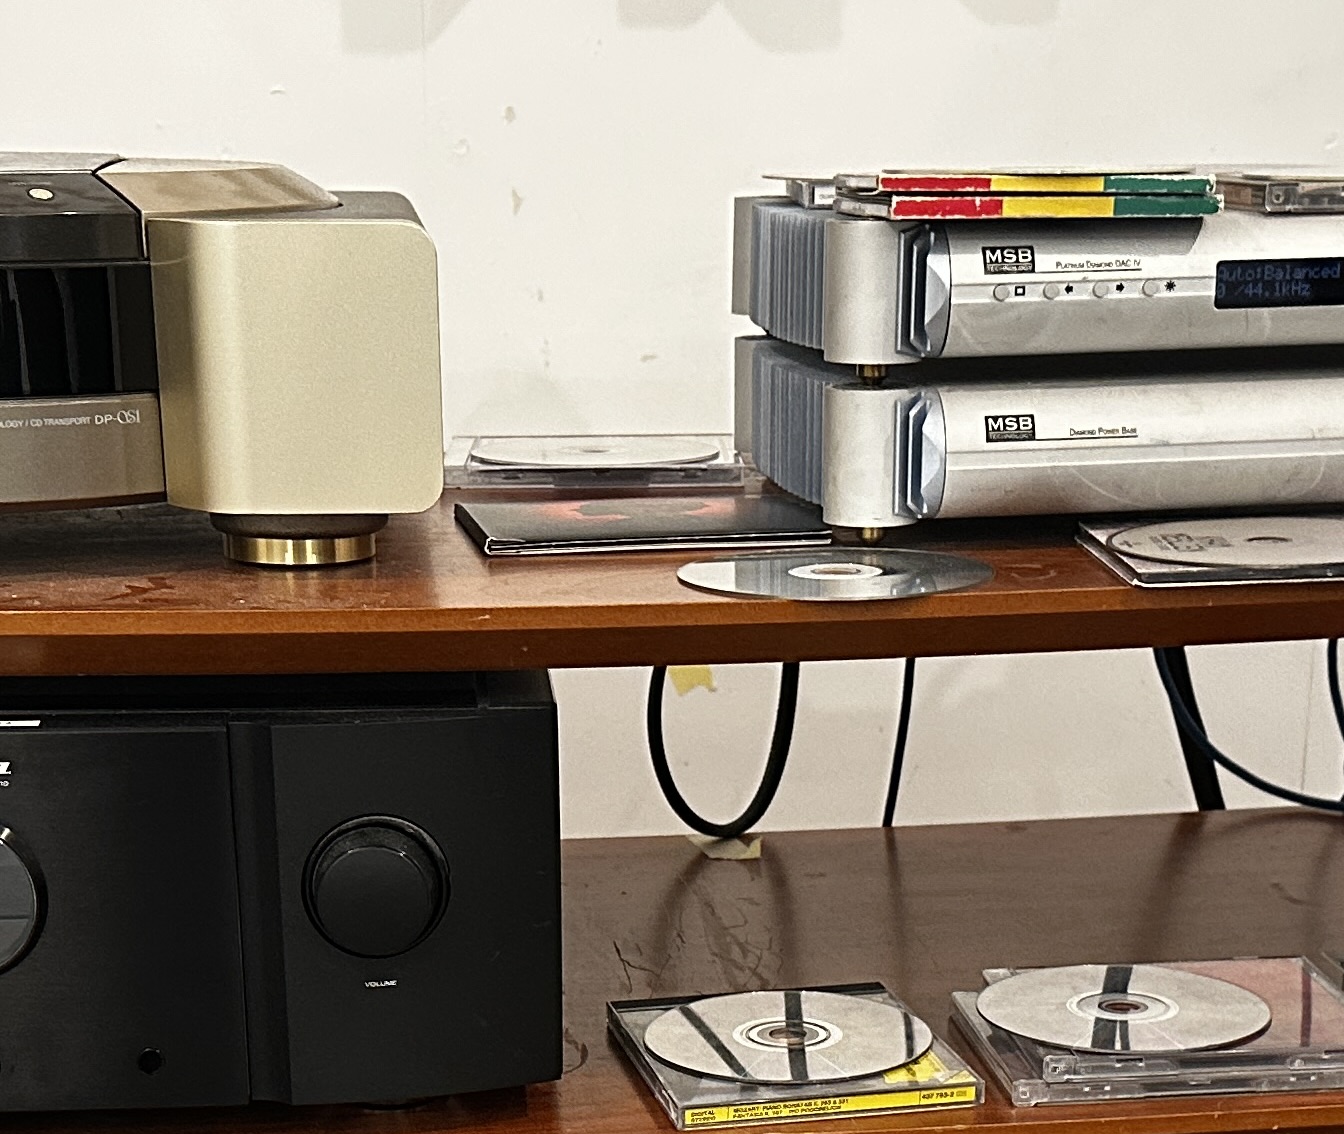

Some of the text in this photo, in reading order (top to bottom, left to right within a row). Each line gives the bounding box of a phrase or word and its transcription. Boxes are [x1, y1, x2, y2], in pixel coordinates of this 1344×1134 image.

[985, 249, 1032, 264] MSB
[1115, 259, 1132, 268] DAC
[30, 419, 43, 427] CD
[44, 417, 92, 426] TRANSPORT
[987, 417, 1033, 431] MSB
